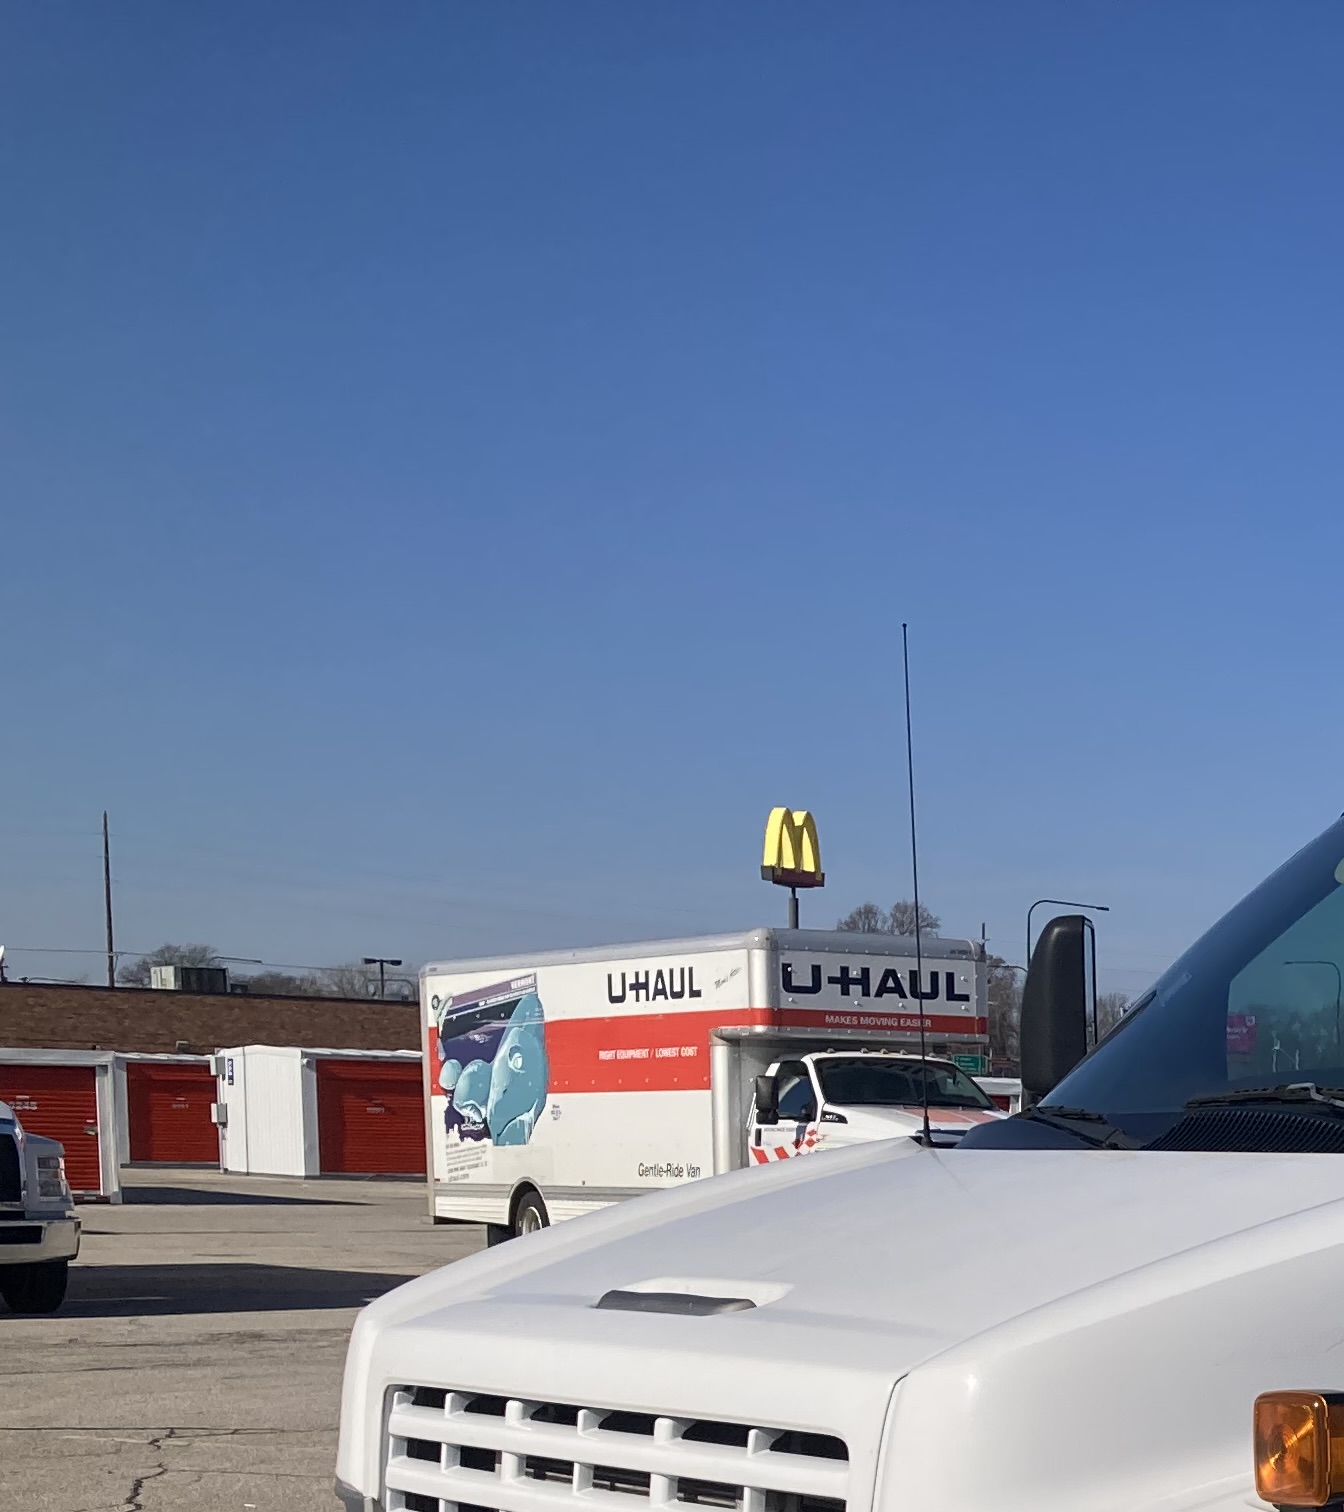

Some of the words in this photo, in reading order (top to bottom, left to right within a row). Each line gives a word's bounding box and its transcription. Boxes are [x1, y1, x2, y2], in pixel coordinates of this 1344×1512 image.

[607, 966, 703, 1004] U-HAUL
[782, 962, 970, 1002] U-HAUL
[825, 1014, 859, 1025] MAKES
[860, 1016, 898, 1027] MOVING
[680, 1046, 698, 1057] COST
[638, 1162, 684, 1178] Gentle-Ride
[686, 1163, 701, 1177] Van
